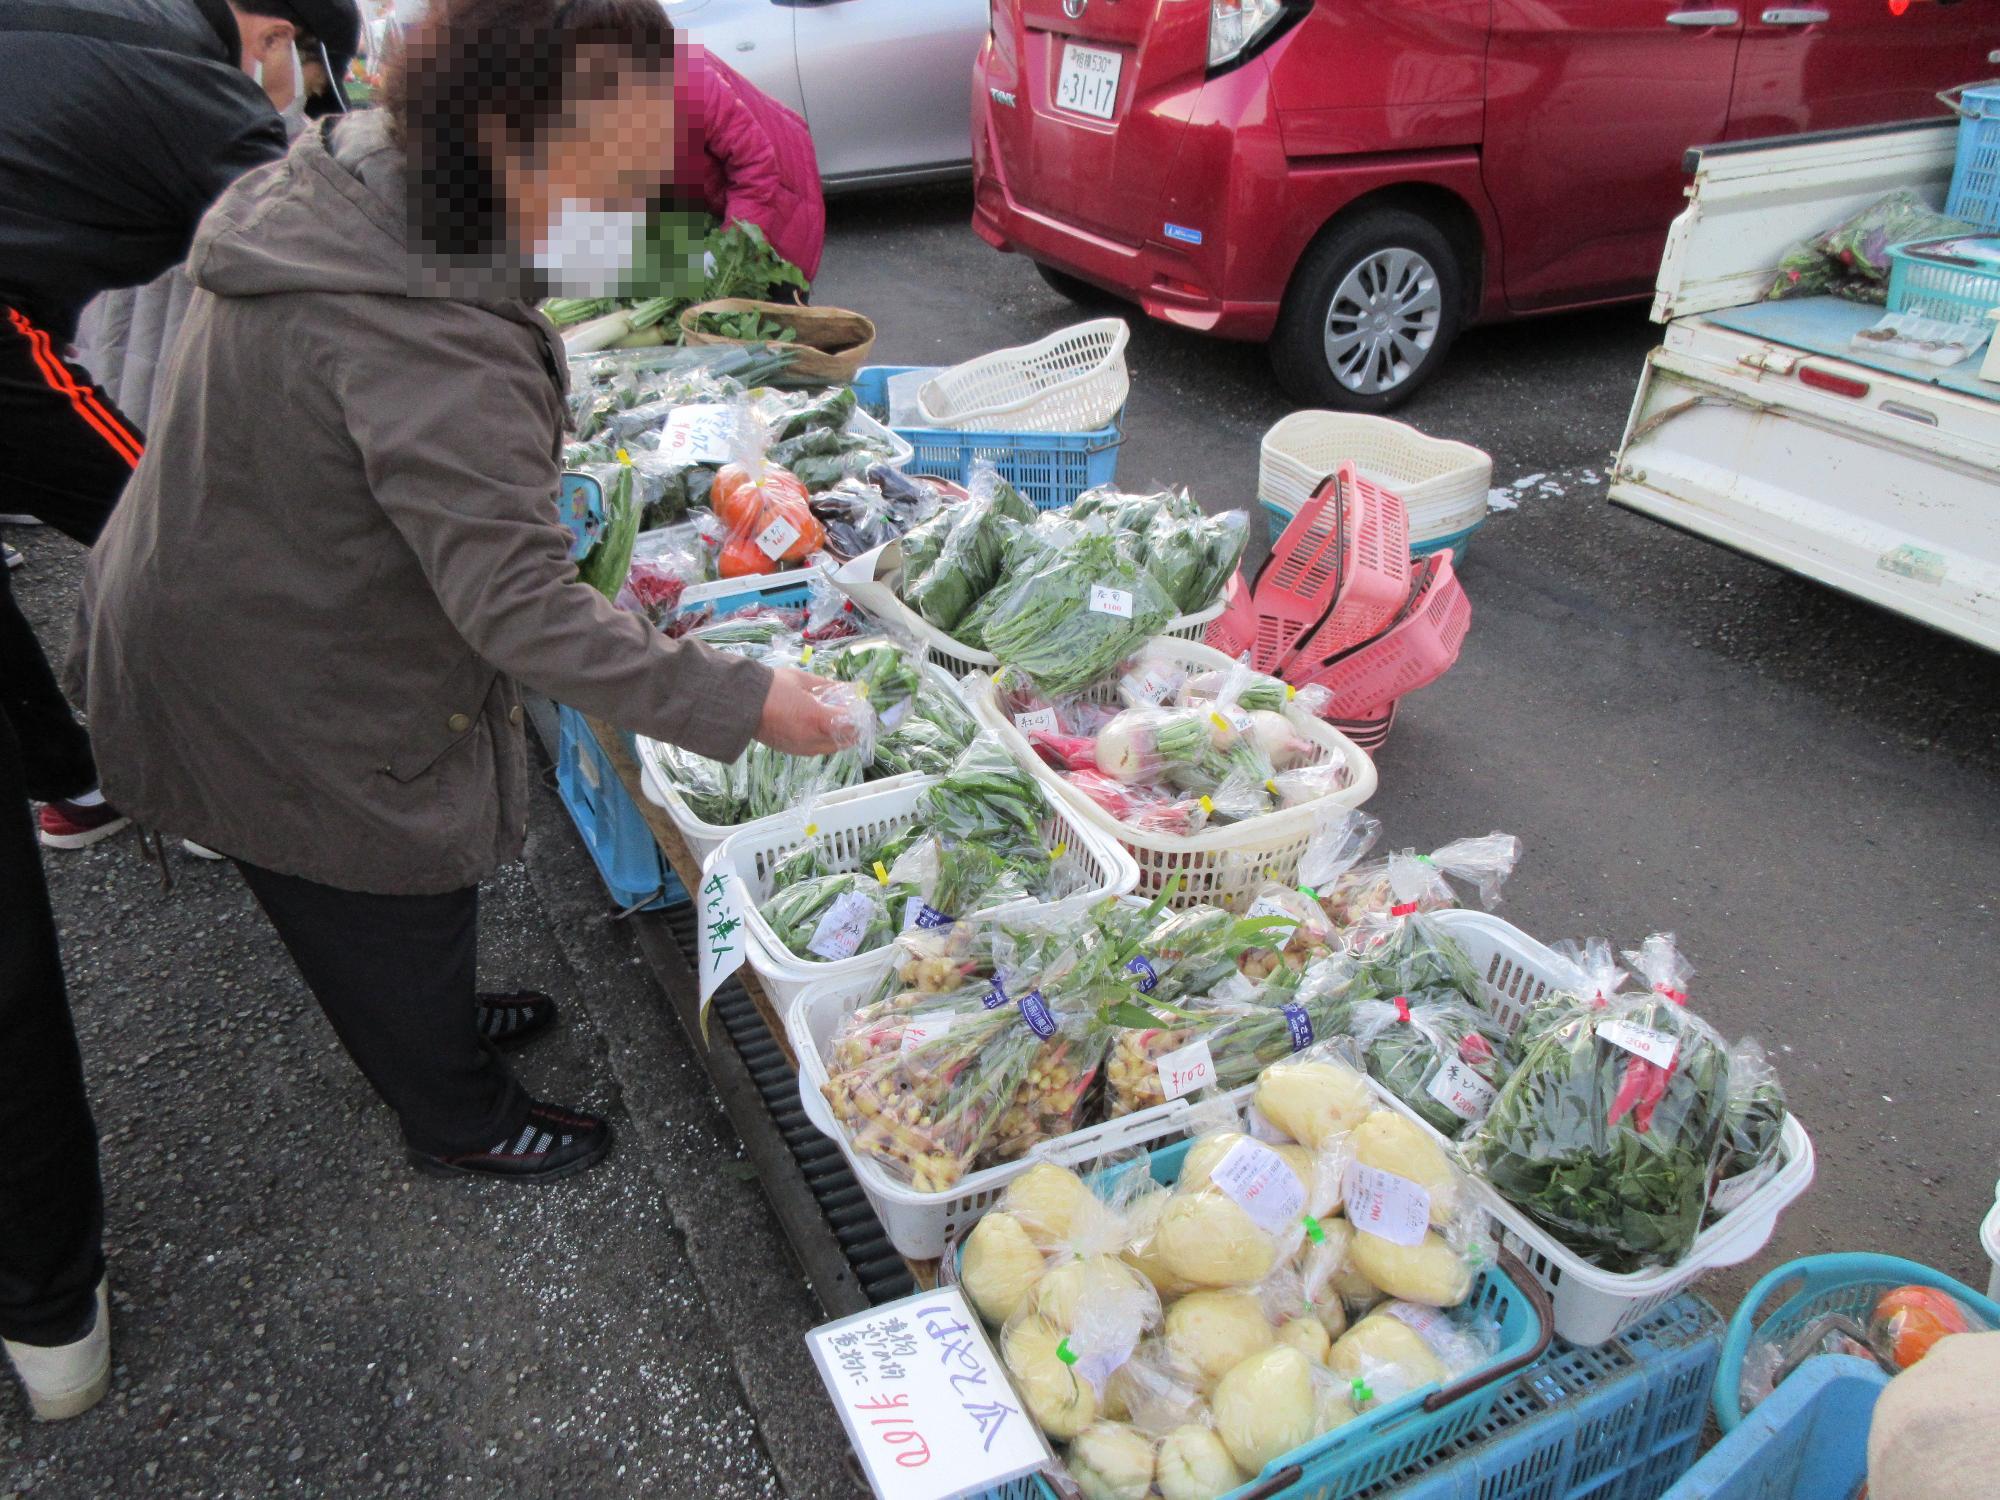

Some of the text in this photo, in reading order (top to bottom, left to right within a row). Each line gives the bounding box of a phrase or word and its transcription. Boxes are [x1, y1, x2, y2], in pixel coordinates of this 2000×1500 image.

[1172, 1063, 1206, 1095] ¥100
[916, 1306, 1019, 1452] はやと瓜
[854, 1393, 931, 1468] ¥100
